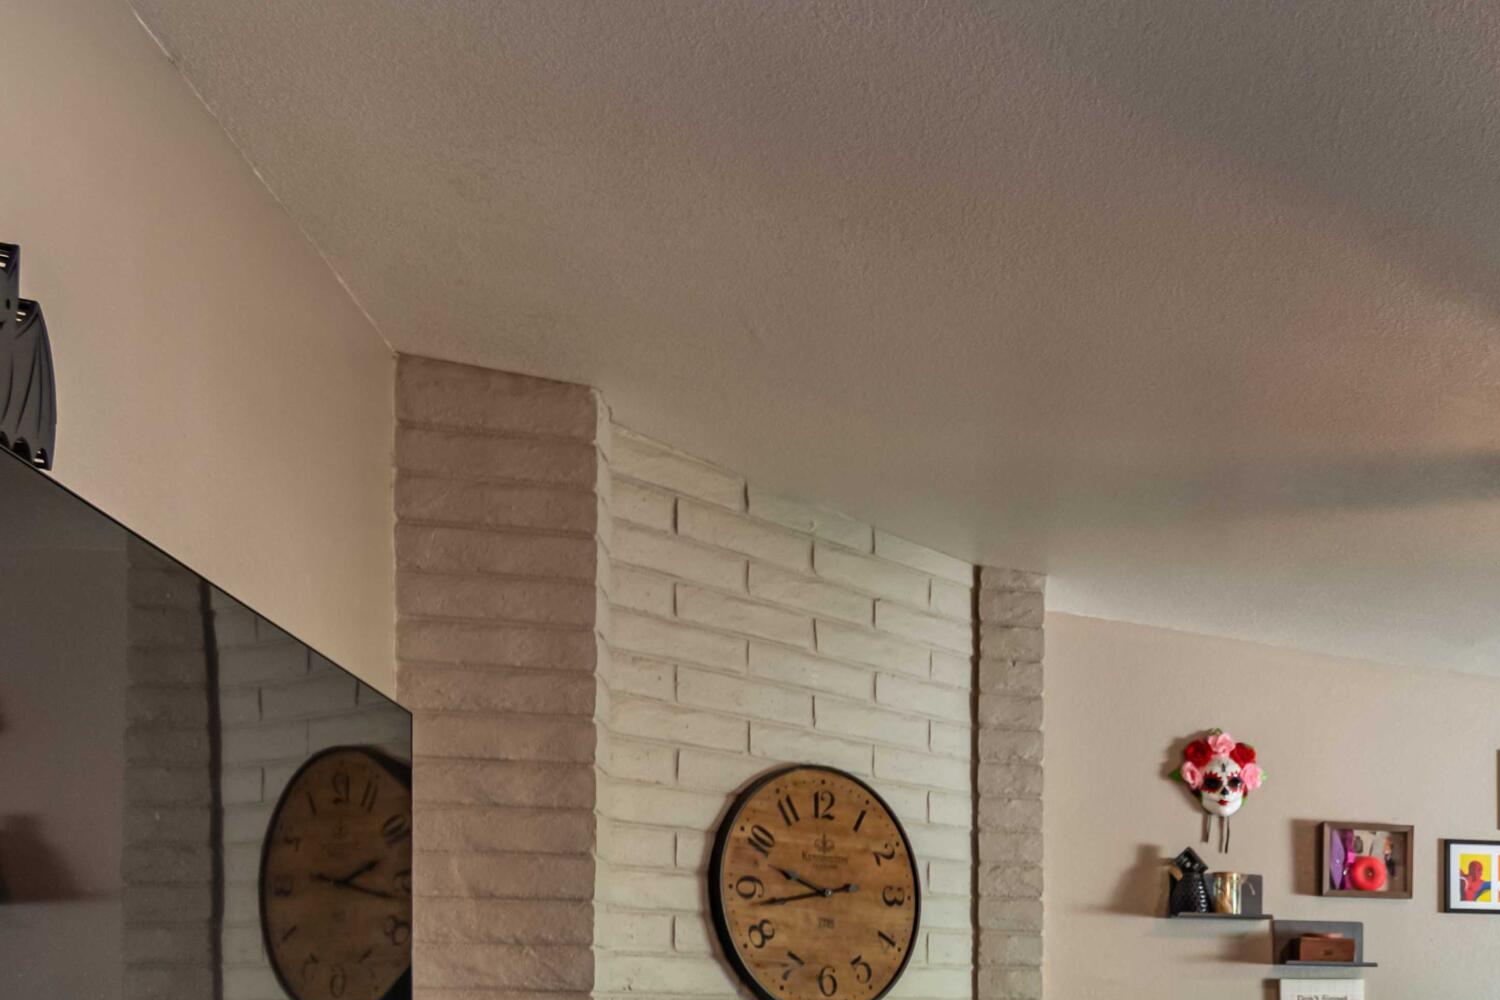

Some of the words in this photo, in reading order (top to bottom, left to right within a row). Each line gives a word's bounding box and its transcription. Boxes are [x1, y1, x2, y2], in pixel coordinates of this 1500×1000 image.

[777, 794, 800, 827] 11
[812, 790, 836, 821] 12
[853, 809, 867, 833] 1
[747, 824, 776, 858] 10
[873, 843, 896, 867] 2
[735, 874, 765, 901] 9
[882, 885, 906, 908] 3
[747, 918, 776, 949] 8
[817, 964, 838, 997] 6
[850, 954, 873, 984] 5
